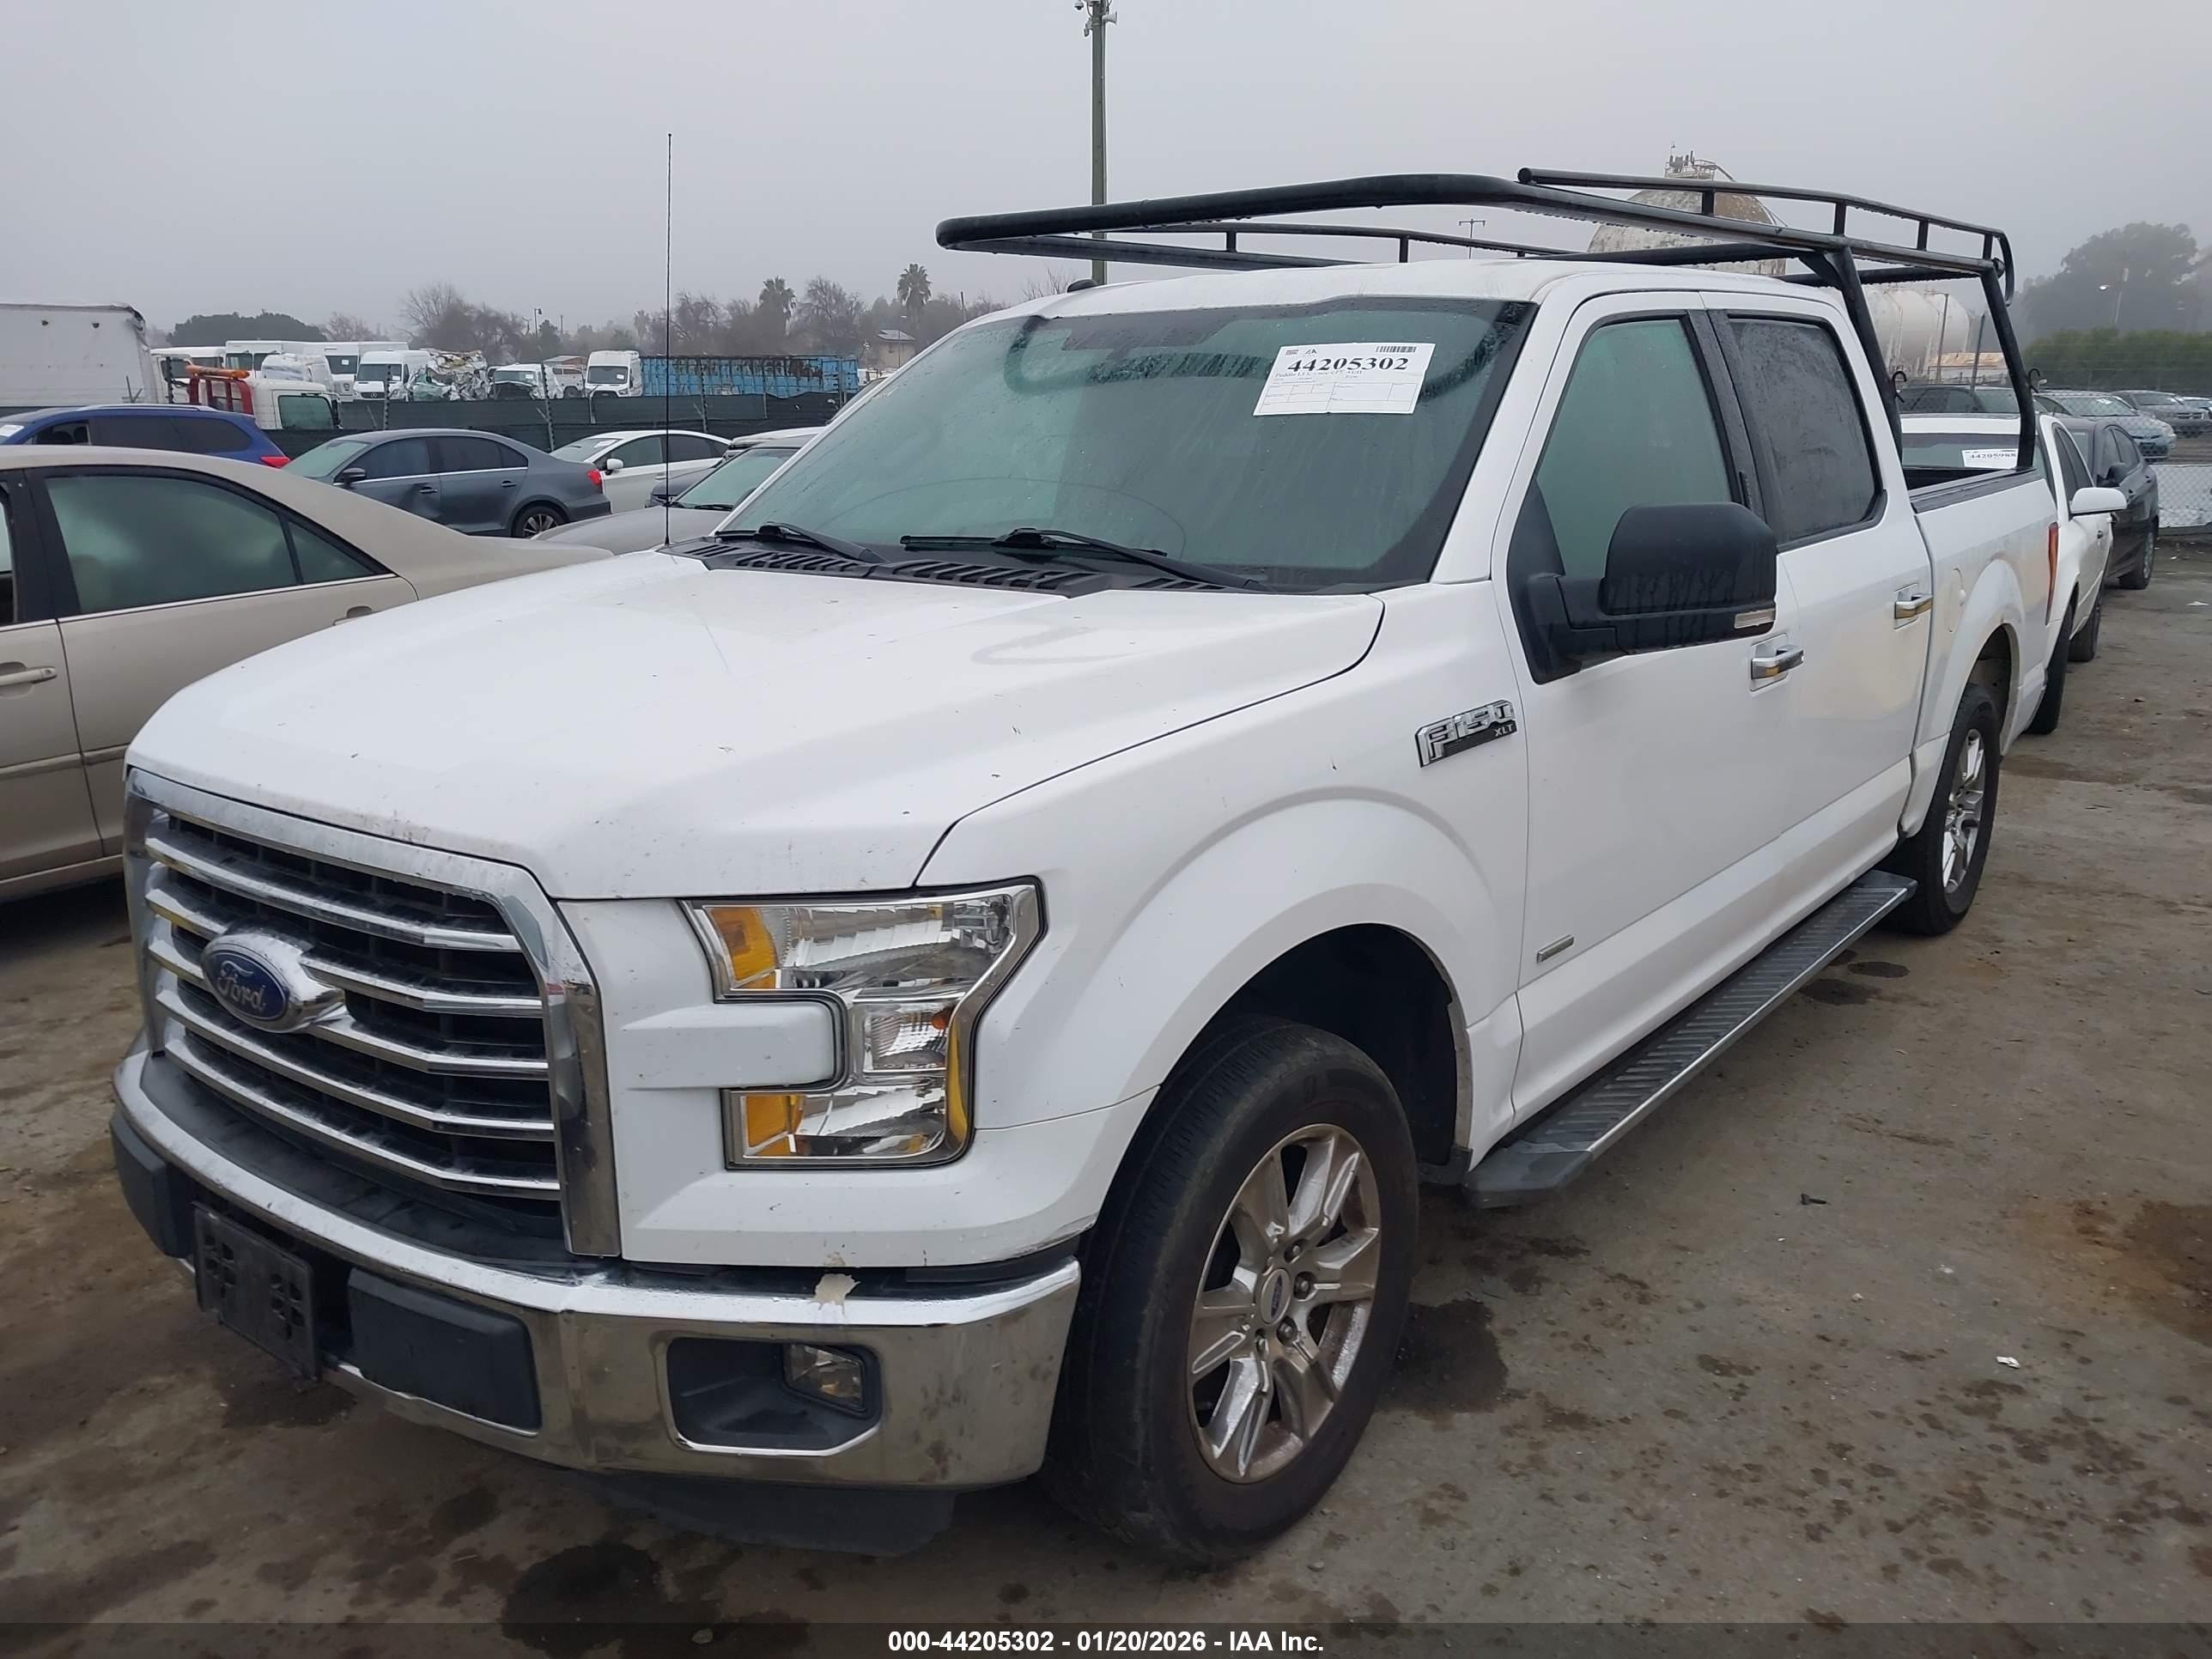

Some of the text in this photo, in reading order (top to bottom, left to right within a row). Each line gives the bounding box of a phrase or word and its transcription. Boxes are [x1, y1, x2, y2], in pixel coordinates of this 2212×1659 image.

[1287, 357, 1408, 373] 44205302
[1494, 724, 1514, 737] XLT
[218, 960, 267, 1012] Ford
